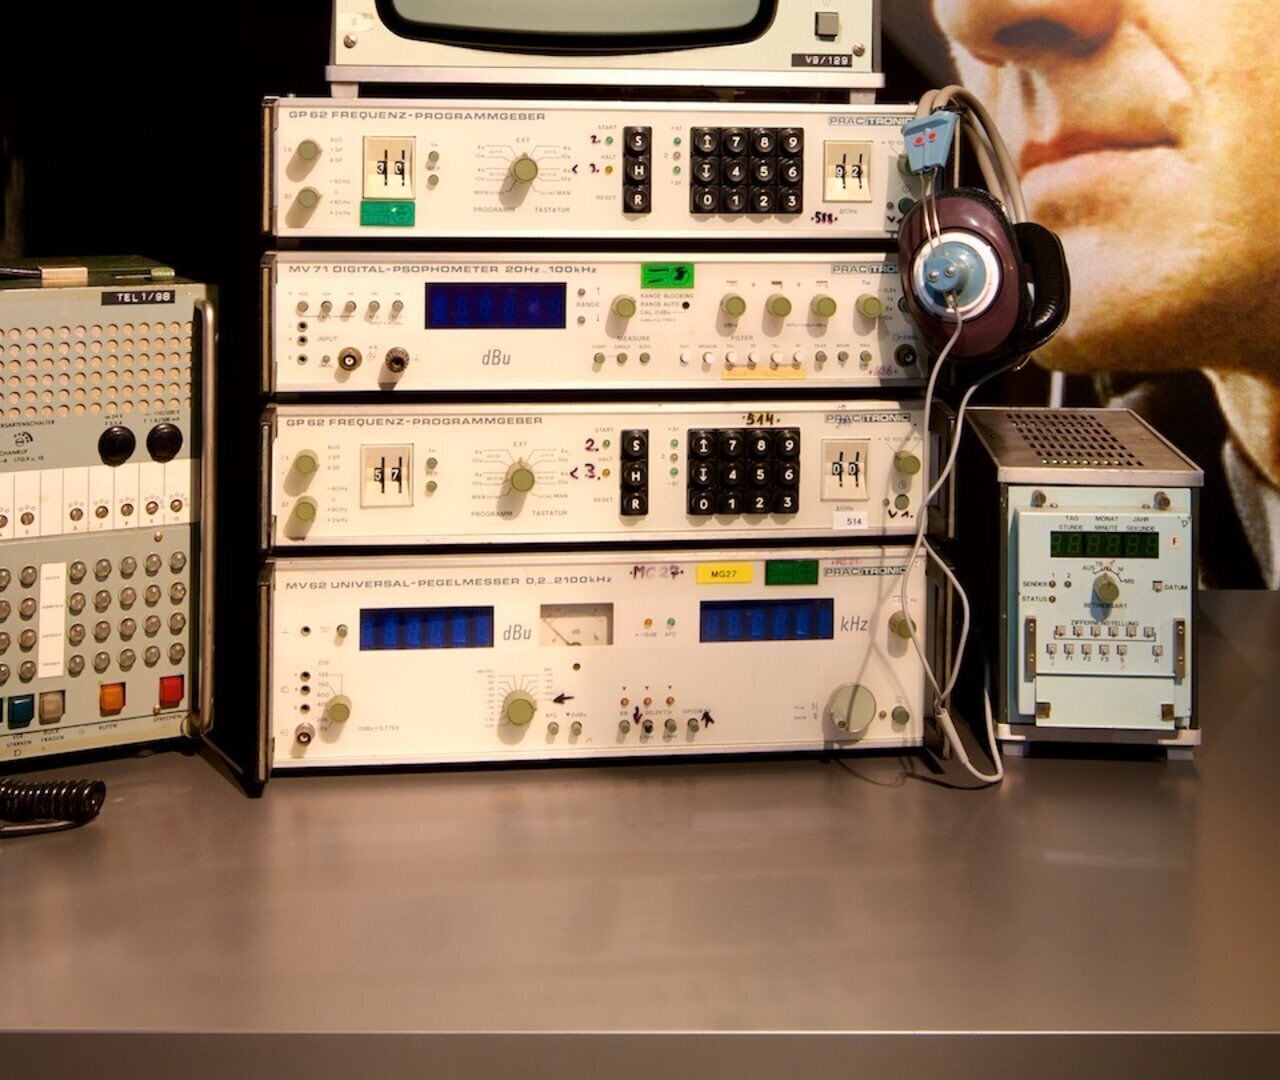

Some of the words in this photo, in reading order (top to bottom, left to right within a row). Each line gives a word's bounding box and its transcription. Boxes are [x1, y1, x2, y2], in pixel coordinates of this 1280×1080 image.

[331, 110, 547, 121] FREQUENZ-PROGRAMMGEBER
[635, 135, 642, 146] S
[732, 136, 741, 148] 7
[760, 136, 769, 148] 8
[788, 136, 797, 148] 9
[634, 165, 644, 176] H
[732, 166, 740, 177] 4
[760, 166, 769, 177] 5
[788, 166, 797, 177] 6
[634, 195, 642, 205] R
[703, 194, 712, 205] 0
[732, 195, 739, 205] 1
[759, 195, 768, 206] 2
[787, 195, 796, 206] 3
[332, 265, 499, 274] DIGITAL-PSOPHOMETER
[831, 263, 899, 274] PRACITRO
[640, 292, 662, 300] RANGE
[663, 292, 694, 300] BLOCKING
[482, 349, 511, 366] dBu
[328, 417, 543, 427] FREQUENZ-PROGRAMMGEBER
[824, 412, 911, 424] PRACITRONIC
[584, 437, 600, 452] 2.
[633, 440, 641, 451] S
[728, 439, 737, 451] 7
[756, 439, 766, 451] 8
[784, 439, 794, 451] 9
[374, 469, 382, 480] 5
[391, 468, 400, 480] 7
[631, 471, 641, 482] H
[728, 468, 737, 479] 4
[756, 468, 765, 479] 5
[784, 469, 794, 479] 6
[632, 499, 640, 510] R
[700, 499, 708, 510] 0
[728, 498, 735, 509] 1
[755, 497, 765, 509] 2
[783, 496, 792, 508] 3
[846, 518, 862, 526] 514
[711, 570, 737, 579] MG27
[330, 578, 520, 589] UNIVERSAL-PEGELMESSER
[840, 616, 869, 632] kHz
[503, 624, 532, 641] dBu
